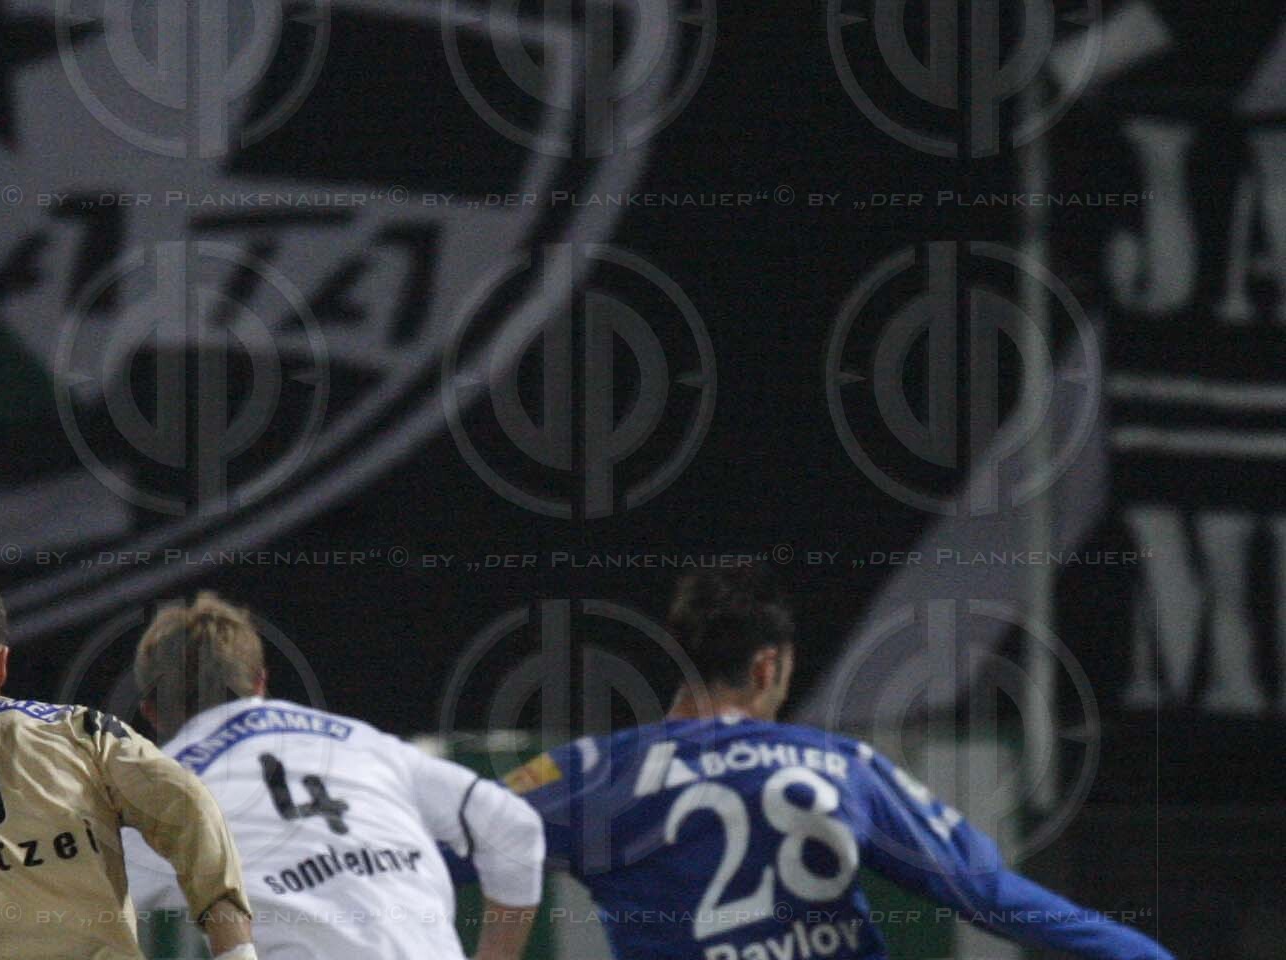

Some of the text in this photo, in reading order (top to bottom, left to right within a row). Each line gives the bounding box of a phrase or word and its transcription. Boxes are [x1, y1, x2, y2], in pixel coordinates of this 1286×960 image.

[258, 753, 350, 836] 4
[699, 739, 850, 779] BÖHLER
[664, 765, 860, 941] 28
